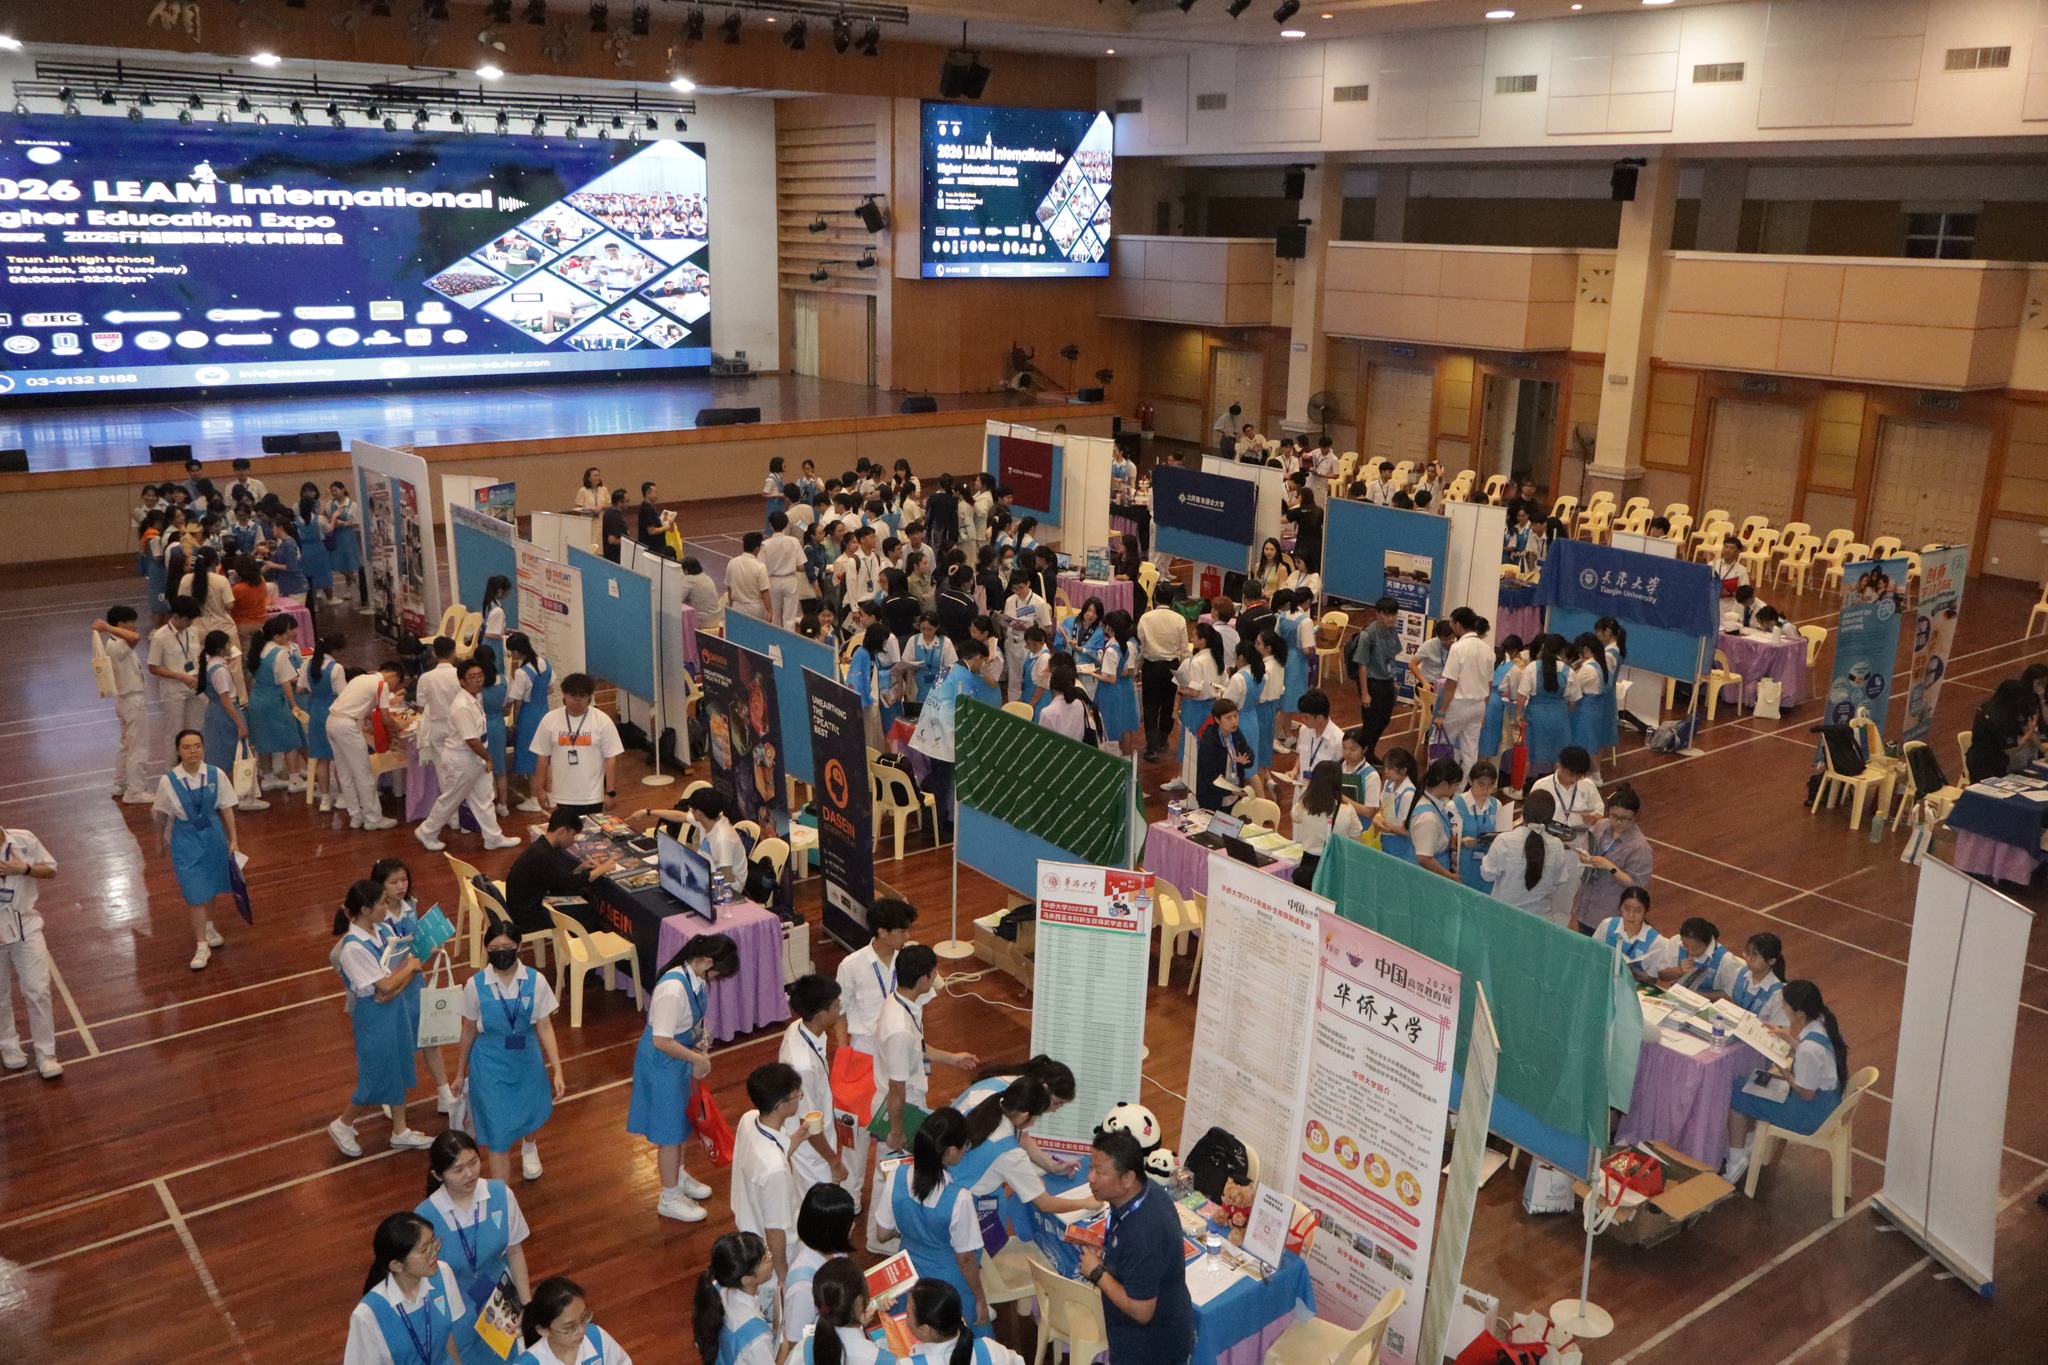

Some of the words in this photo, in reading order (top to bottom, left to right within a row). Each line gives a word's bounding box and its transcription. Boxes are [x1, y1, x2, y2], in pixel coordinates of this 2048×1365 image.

[93, 180, 217, 203] LEAM
[230, 184, 493, 208] International
[87, 210, 252, 227] Education
[261, 212, 336, 230] Expo
[6, 255, 43, 264] Tsun
[46, 256, 69, 264] Jin
[70, 255, 105, 265] High
[107, 256, 154, 265] School
[7, 266, 22, 274] 17
[24, 266, 76, 275] March,
[78, 266, 113, 274] 2026
[115, 265, 187, 275] (Tuesday)
[41, 313, 78, 324] JEIC
[26, 375, 95, 387] 03-9132
[99, 374, 137, 384] 8188
[1023, 471, 1043, 479] UNIVERSITY
[1386, 580, 1415, 592] 天津大学
[1600, 586, 1622, 597] Tianjin
[1623, 590, 1657, 605] University
[811, 695, 847, 720] UNEARTHING
[812, 705, 824, 718] THE
[813, 715, 840, 736] CREATIVE
[814, 725, 828, 739] BEST
[822, 805, 856, 839] DASEIN
[1043, 901, 1095, 915] 华侨大学2023年度
[1287, 898, 1305, 916] 中国
[1043, 911, 1135, 930] 马来西亚本科新生获得奖学金名单
[1375, 957, 1408, 989] 中国
[1407, 977, 1452, 1006] 高等教育展
[1427, 977, 1453, 994] 2025
[1333, 982, 1422, 1044] 华侨大学
